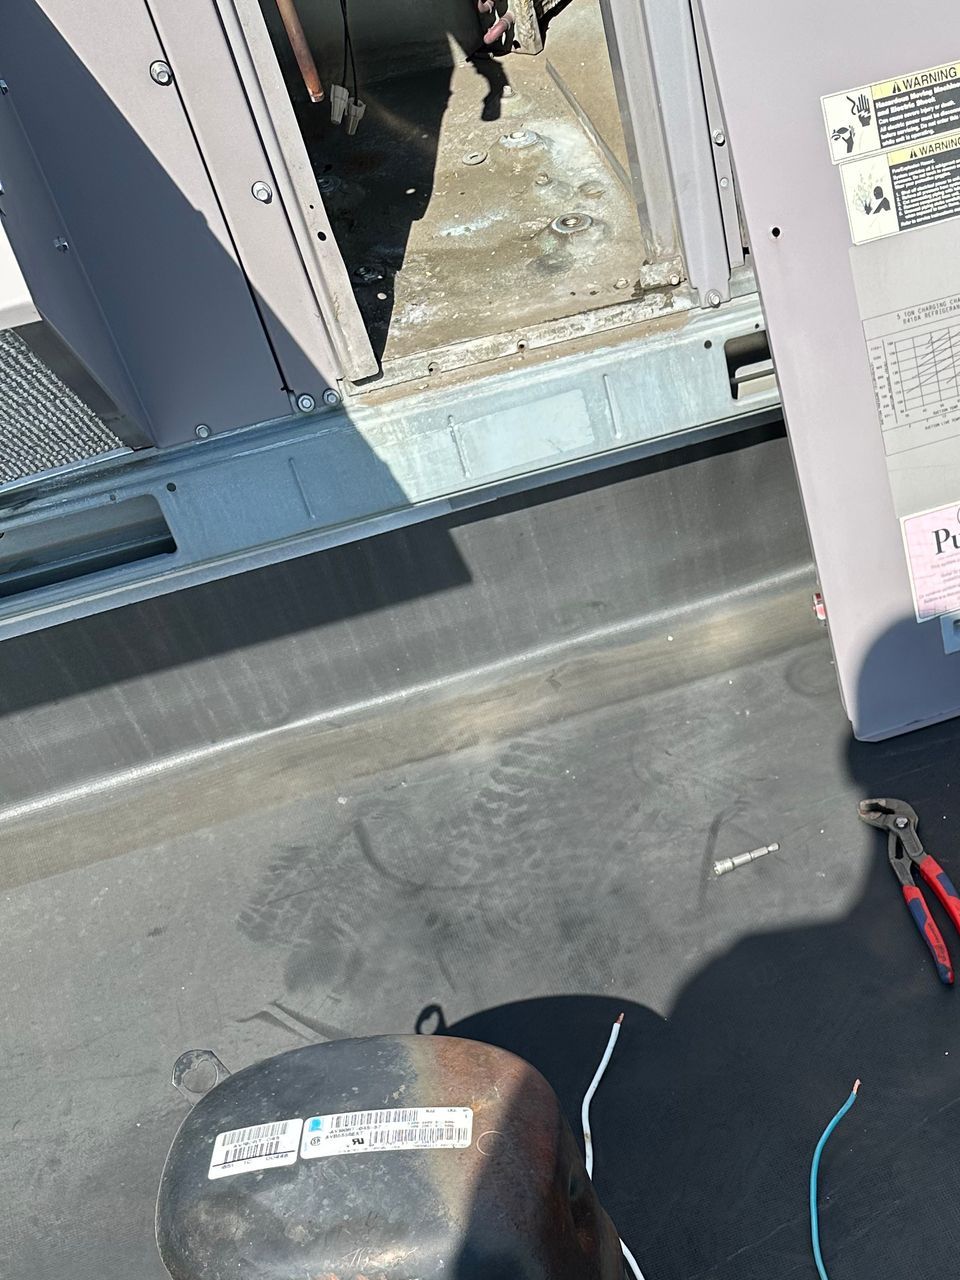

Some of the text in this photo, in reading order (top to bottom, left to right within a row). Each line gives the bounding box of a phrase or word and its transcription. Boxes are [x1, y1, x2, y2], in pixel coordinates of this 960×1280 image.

[902, 67, 957, 91] WARNING
[904, 309, 915, 317] TON
[917, 300, 945, 313] CHARGING
